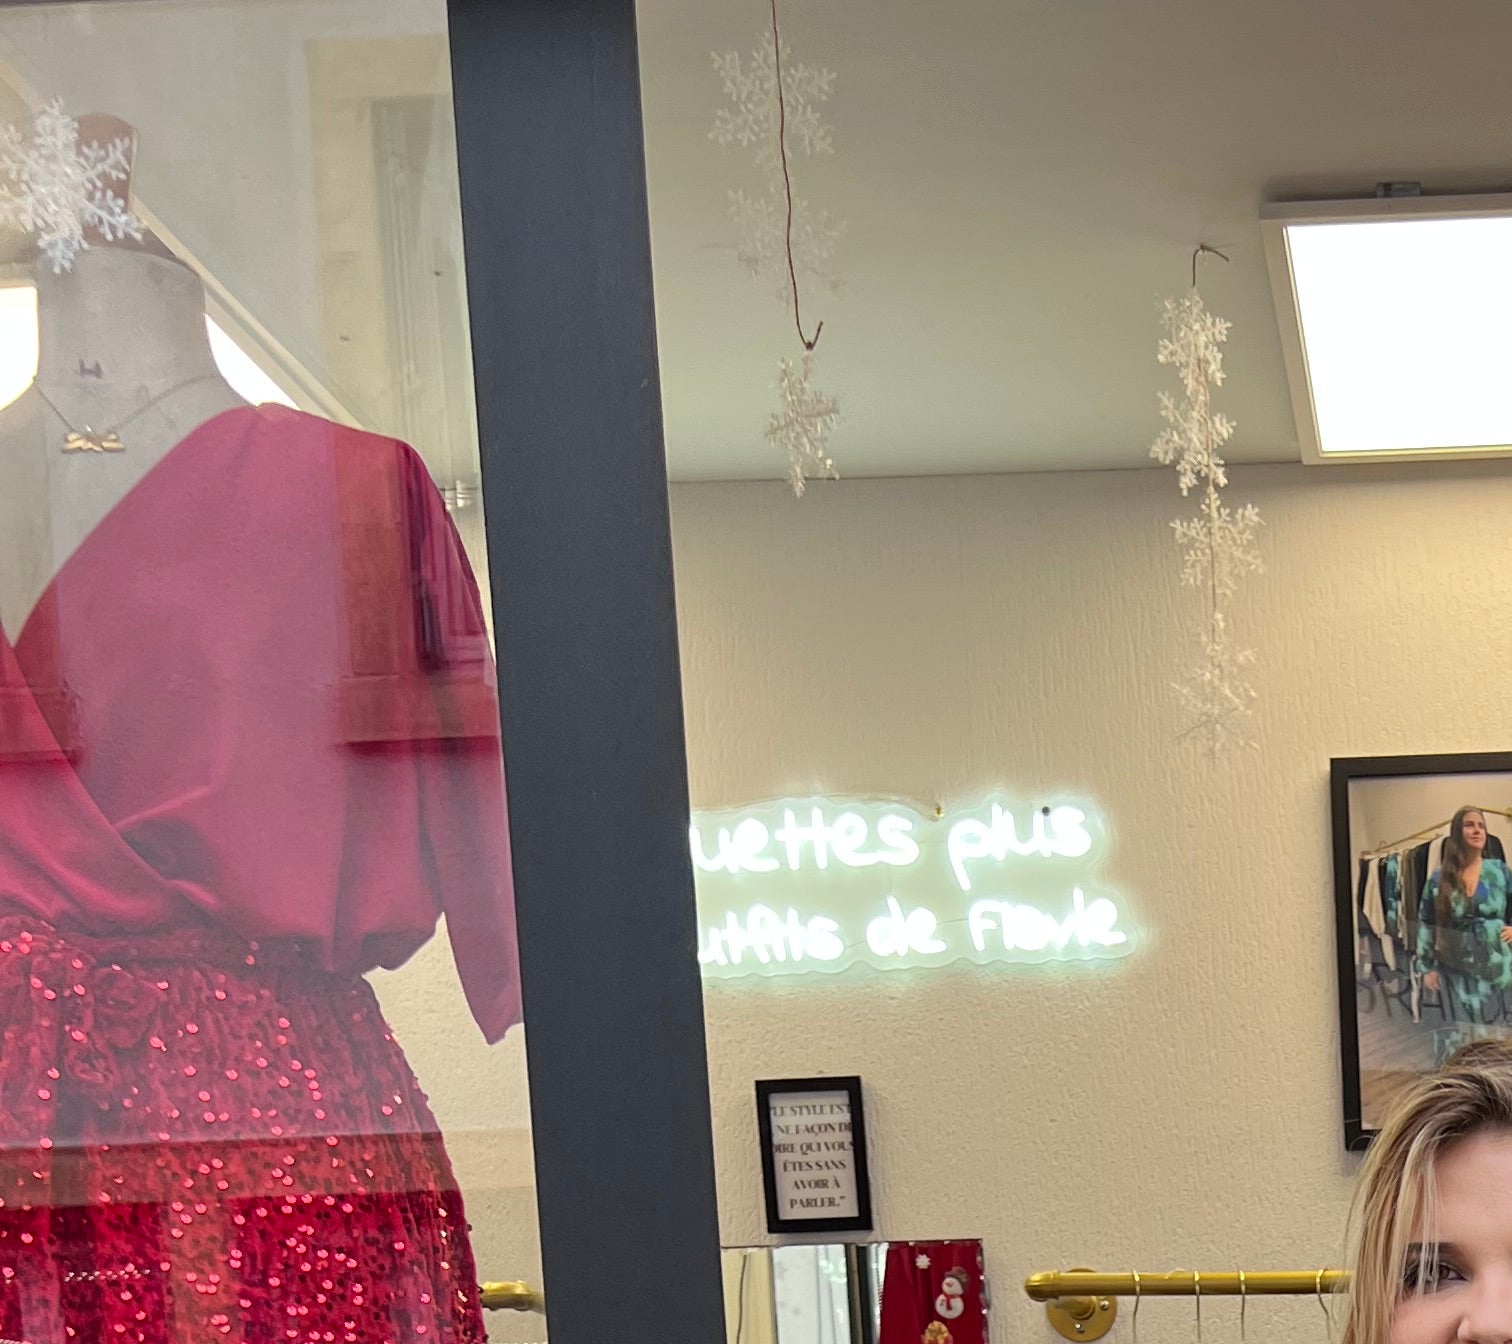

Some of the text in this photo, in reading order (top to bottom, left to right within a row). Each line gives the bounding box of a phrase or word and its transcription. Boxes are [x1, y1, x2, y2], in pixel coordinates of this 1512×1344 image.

[948, 803, 1091, 891] plus
[867, 895, 946, 956] de
[789, 1104, 825, 1116] STYLE
[800, 1142, 822, 1156] QUI
[792, 1178, 830, 1190] AVOIR
